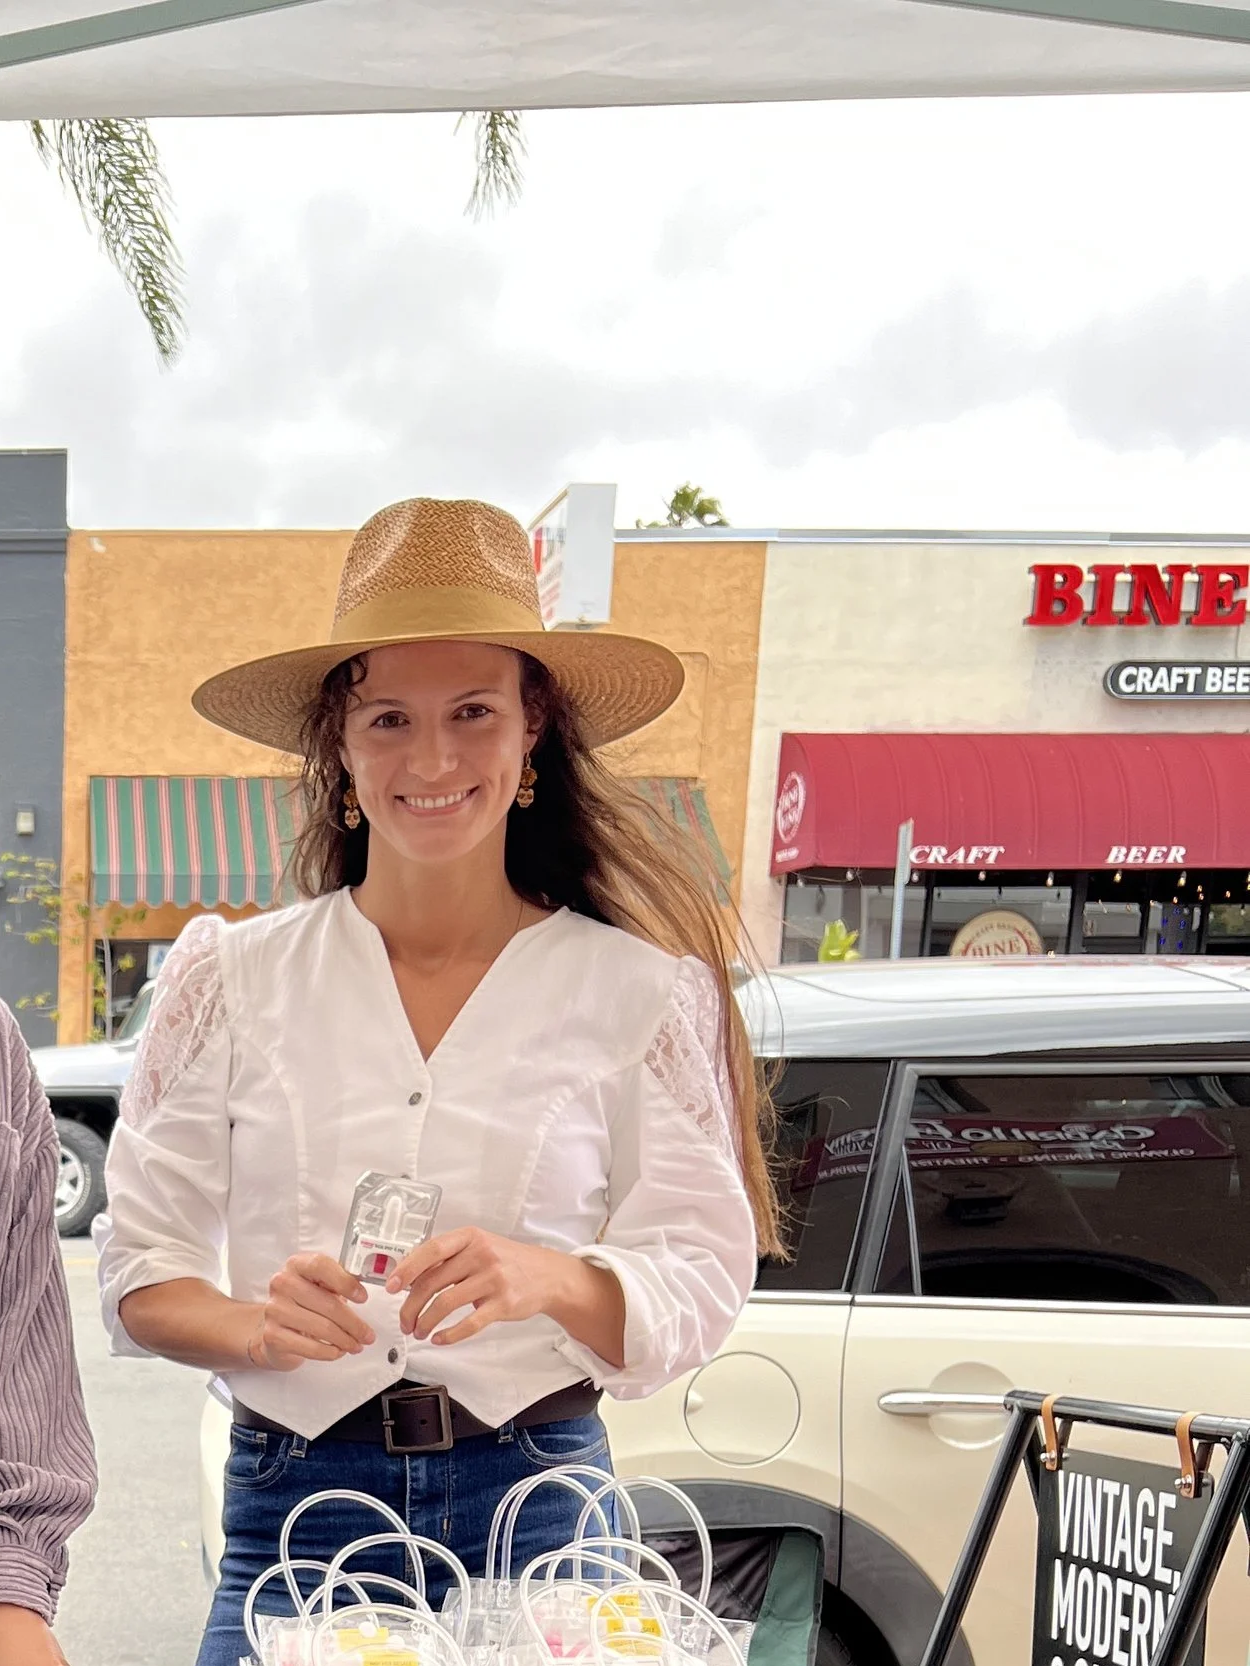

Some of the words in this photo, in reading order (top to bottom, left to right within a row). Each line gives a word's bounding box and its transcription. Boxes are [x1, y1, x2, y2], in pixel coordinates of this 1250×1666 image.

[1022, 563, 1250, 627] BINE
[1118, 666, 1201, 693] CRAFT
[909, 845, 1005, 864] CRAFT
[1105, 845, 1186, 864] BEER
